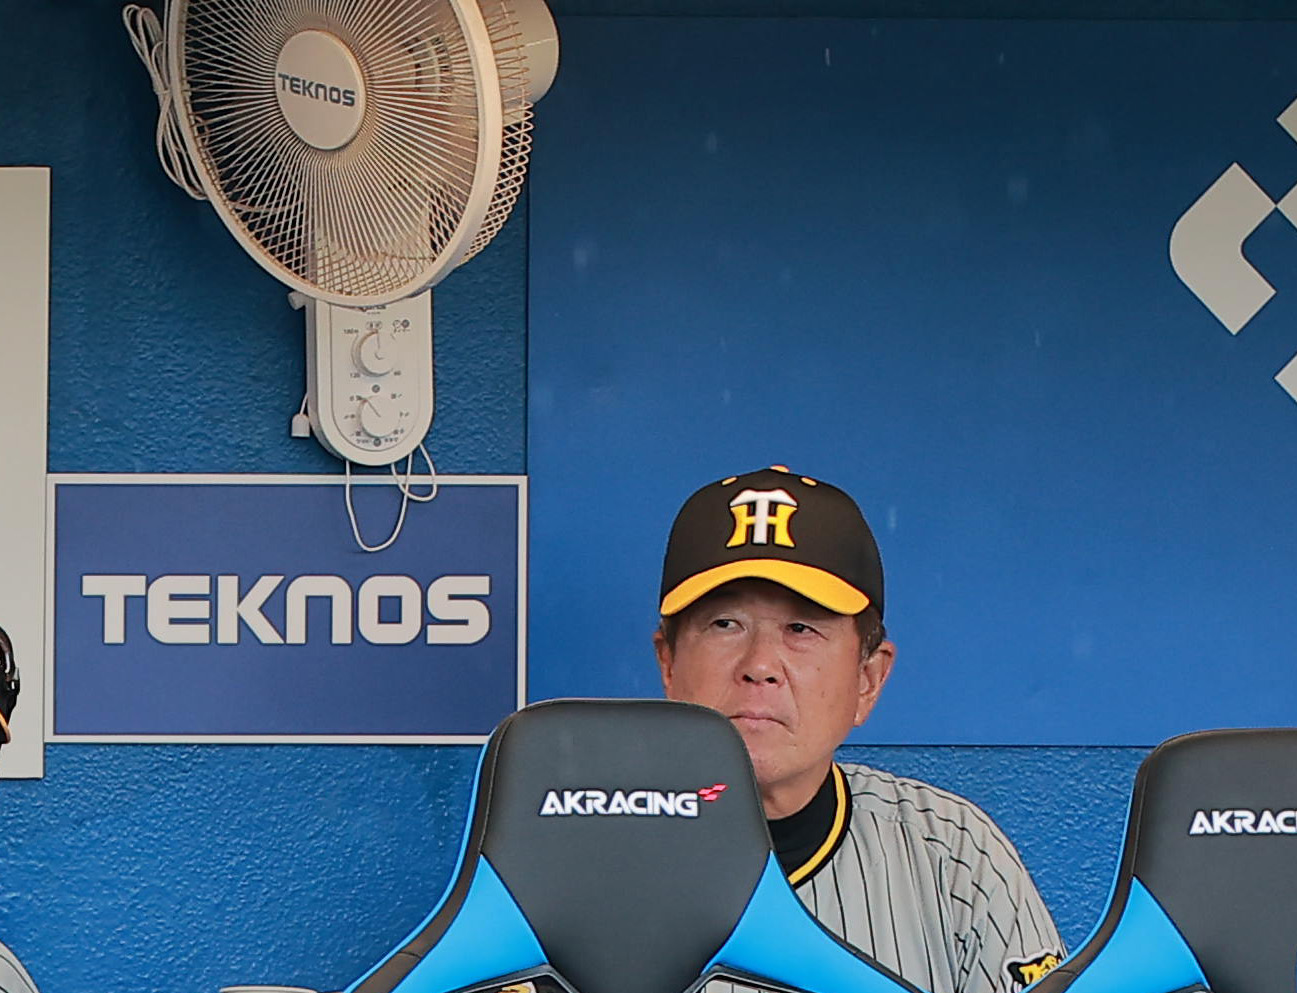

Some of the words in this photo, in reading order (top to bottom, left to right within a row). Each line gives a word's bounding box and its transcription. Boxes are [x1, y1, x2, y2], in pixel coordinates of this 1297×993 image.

[278, 73, 356, 107] TEKNOS
[81, 574, 492, 645] TEKNOS
[538, 790, 699, 817] AKRACING
[1188, 809, 1297, 835] AKRAC
